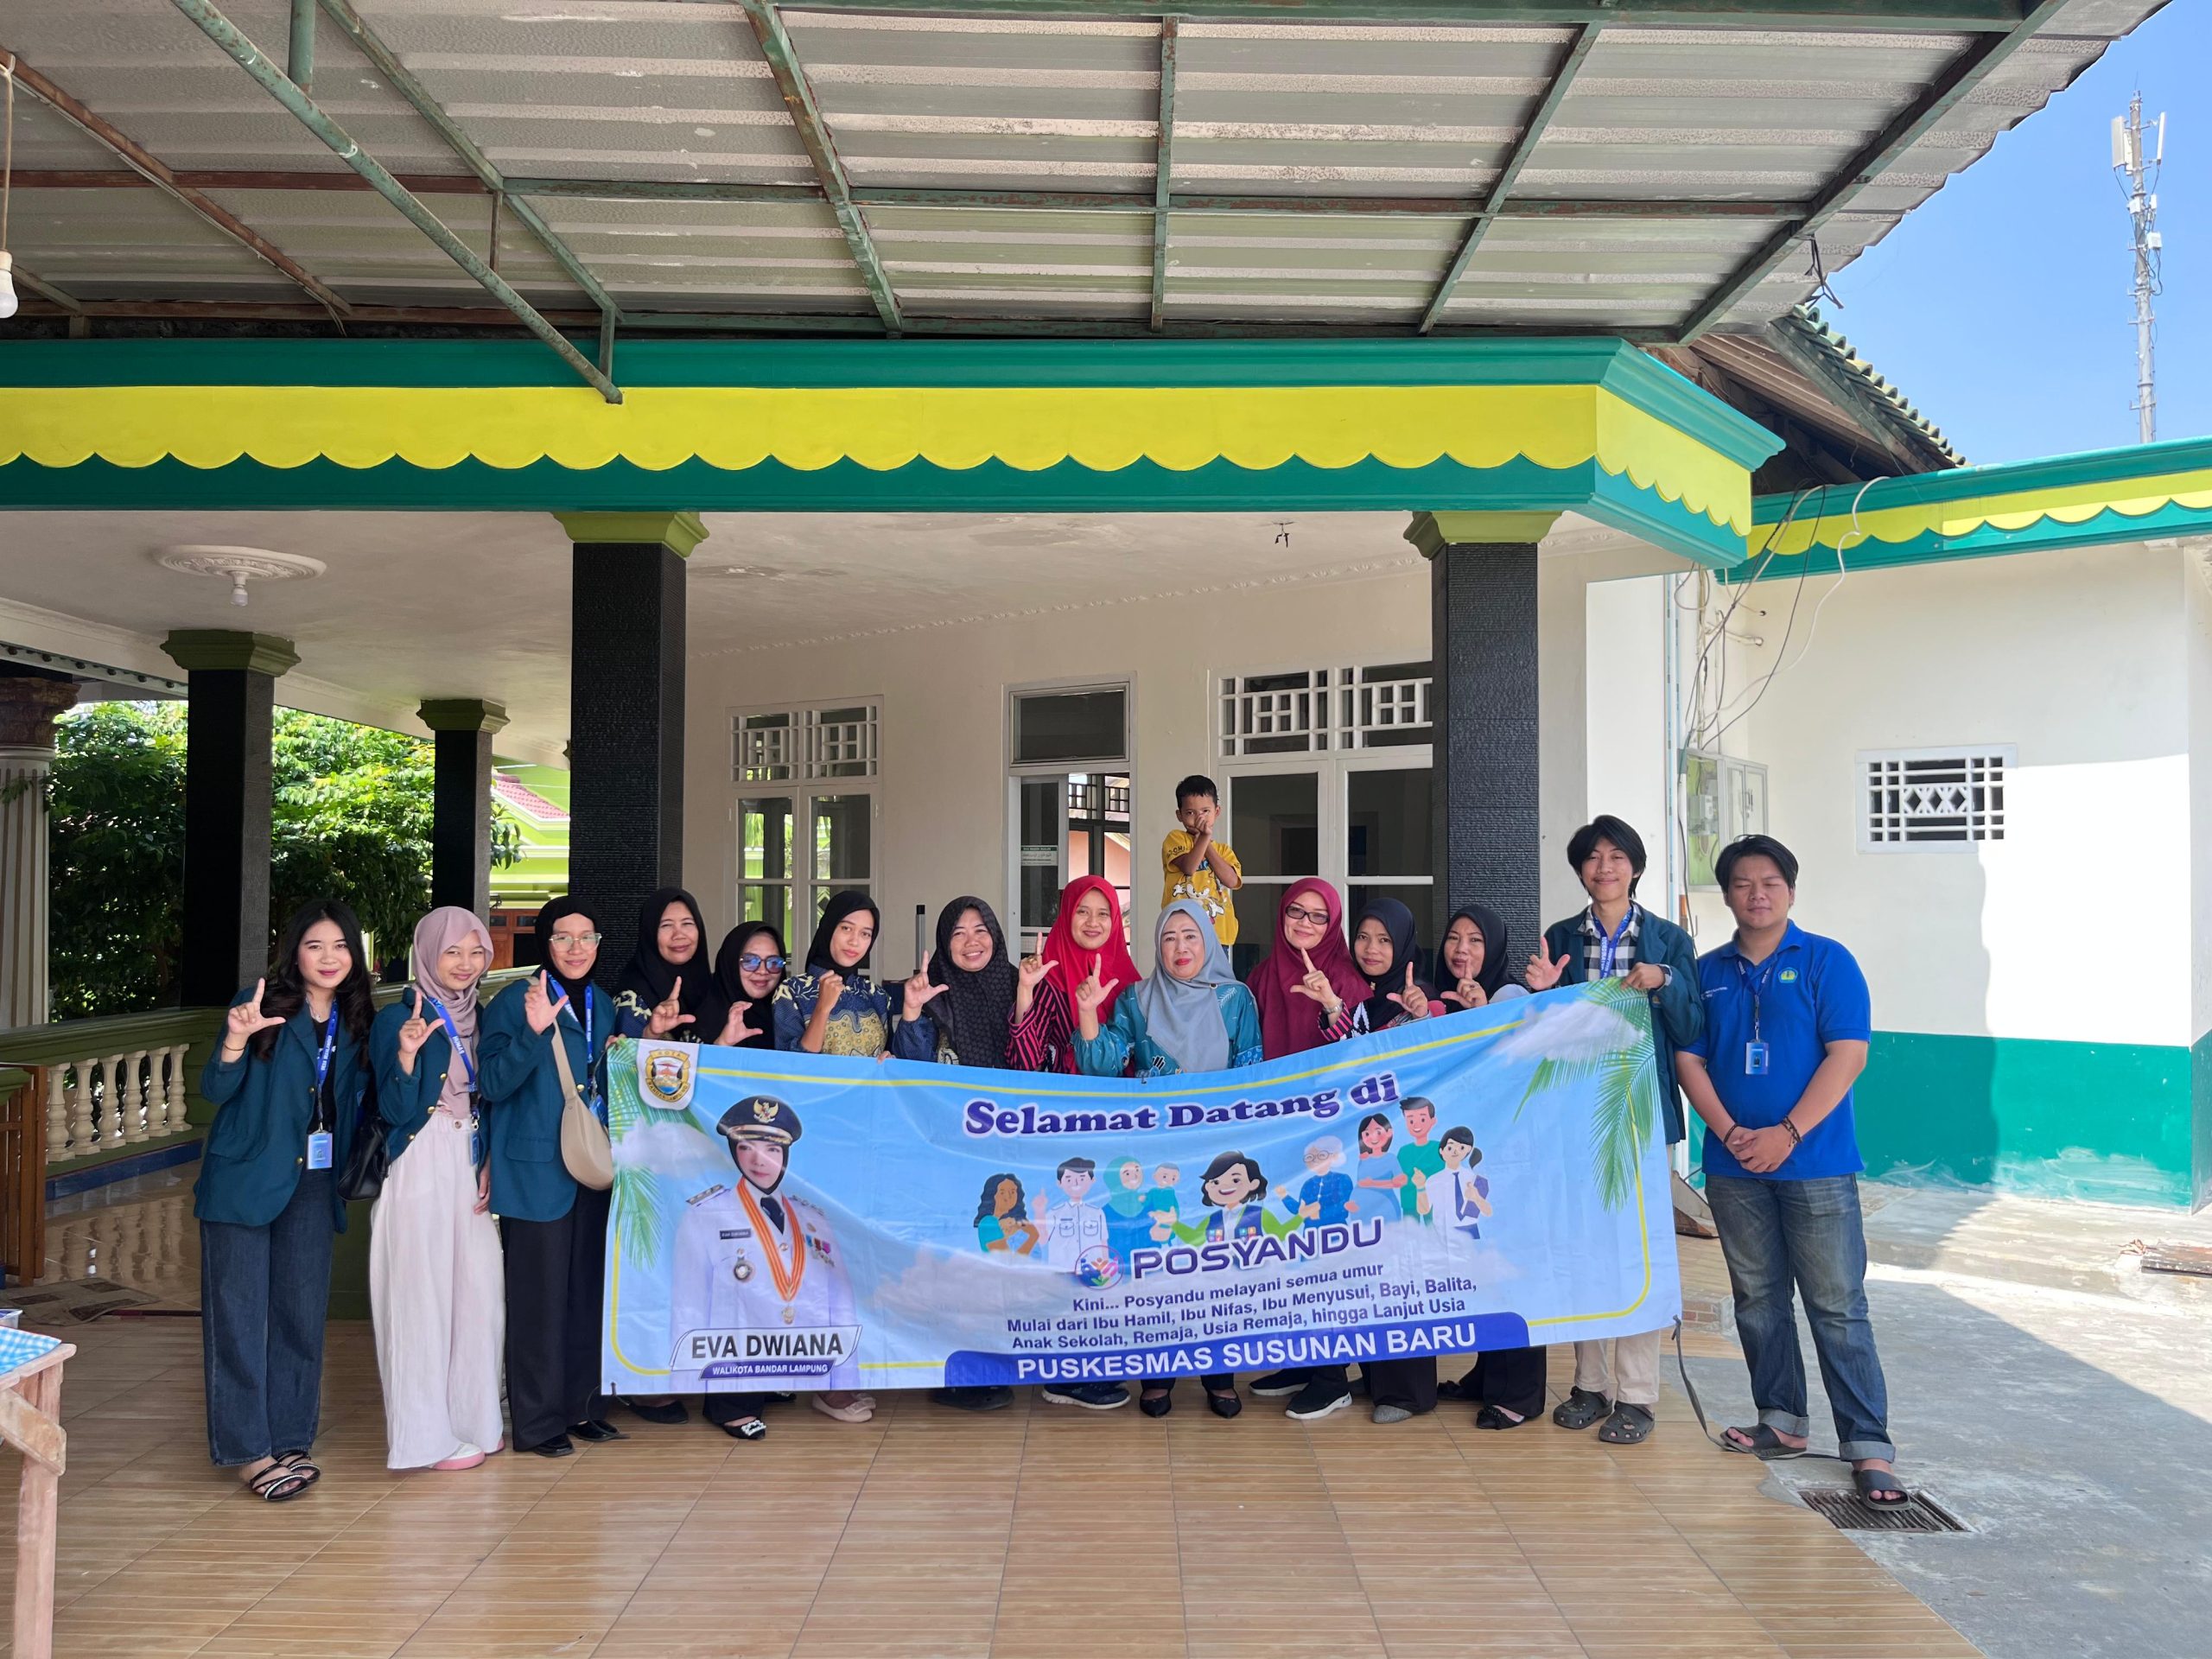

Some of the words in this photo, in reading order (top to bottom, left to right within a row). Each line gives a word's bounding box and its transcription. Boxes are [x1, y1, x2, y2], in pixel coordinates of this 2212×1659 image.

[965, 1101, 1156, 1135] Selamat
[1168, 1090, 1340, 1127] Datang
[1350, 1073, 1400, 1105] di
[1134, 1219, 1382, 1279] POSYANDU
[1007, 1319, 1052, 1332] Mulai
[1056, 1318, 1088, 1331] dari
[1093, 1316, 1119, 1329] Ibu
[1125, 1312, 1176, 1327] Hamil,
[1180, 1307, 1206, 1321] Ibu
[1211, 1302, 1257, 1318] Nifas,
[1262, 1298, 1287, 1311] Ibu
[1293, 1284, 1375, 1306] Menyusui,
[1380, 1281, 1421, 1300] Bayi,
[1425, 1277, 1477, 1294] Balita,
[1073, 1298, 1120, 1312] Kini...
[1125, 1290, 1205, 1309] Posyandu
[1210, 1277, 1281, 1300] melayani
[1286, 1271, 1338, 1287] semua
[1342, 1264, 1383, 1279] umur
[691, 1335, 738, 1359] EVA
[746, 1332, 843, 1357] DWIANA
[1012, 1336, 1052, 1349] Anak
[1058, 1333, 1128, 1349] Sekolah,
[1134, 1326, 1198, 1344] Remaja,
[1203, 1320, 1238, 1336] Usia
[1243, 1311, 1307, 1331] Remaja,
[1313, 1306, 1369, 1325] hingga
[1373, 1300, 1425, 1319] Lanjut
[1429, 1298, 1465, 1313] Usia
[713, 1365, 753, 1376] WALIKOTA
[754, 1364, 788, 1374] BANDAR
[789, 1363, 828, 1373] LAMPUNG
[1017, 1346, 1213, 1380] PUSKESMAS
[1223, 1332, 1376, 1367] SUSUNAN
[1386, 1322, 1476, 1353] BARU
